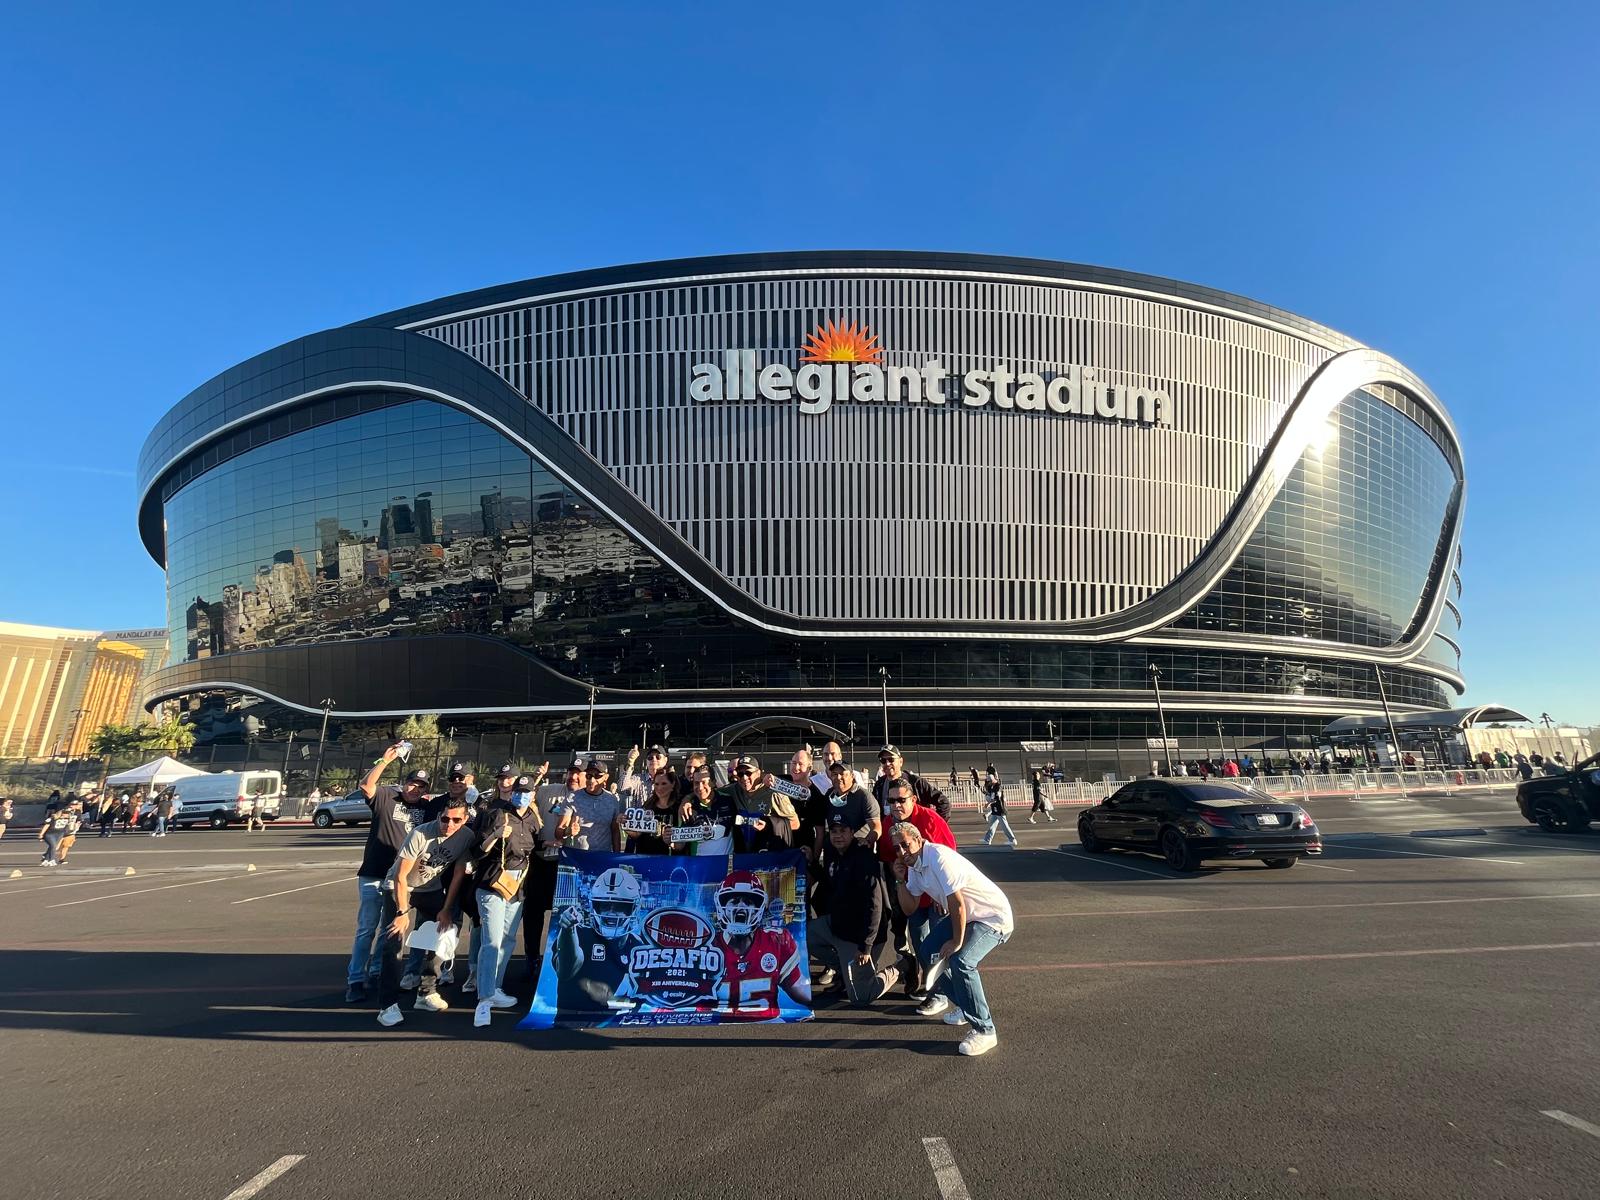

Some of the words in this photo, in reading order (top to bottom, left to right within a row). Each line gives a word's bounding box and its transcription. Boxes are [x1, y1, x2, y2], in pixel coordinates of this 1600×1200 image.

[690, 348, 946, 415] allegiant
[963, 361, 1172, 425] stadium
[627, 809, 643, 821] GO
[623, 820, 655, 831] TEAM!
[634, 946, 719, 972] DESAFÍO
[619, 1016, 651, 1025] LAS
